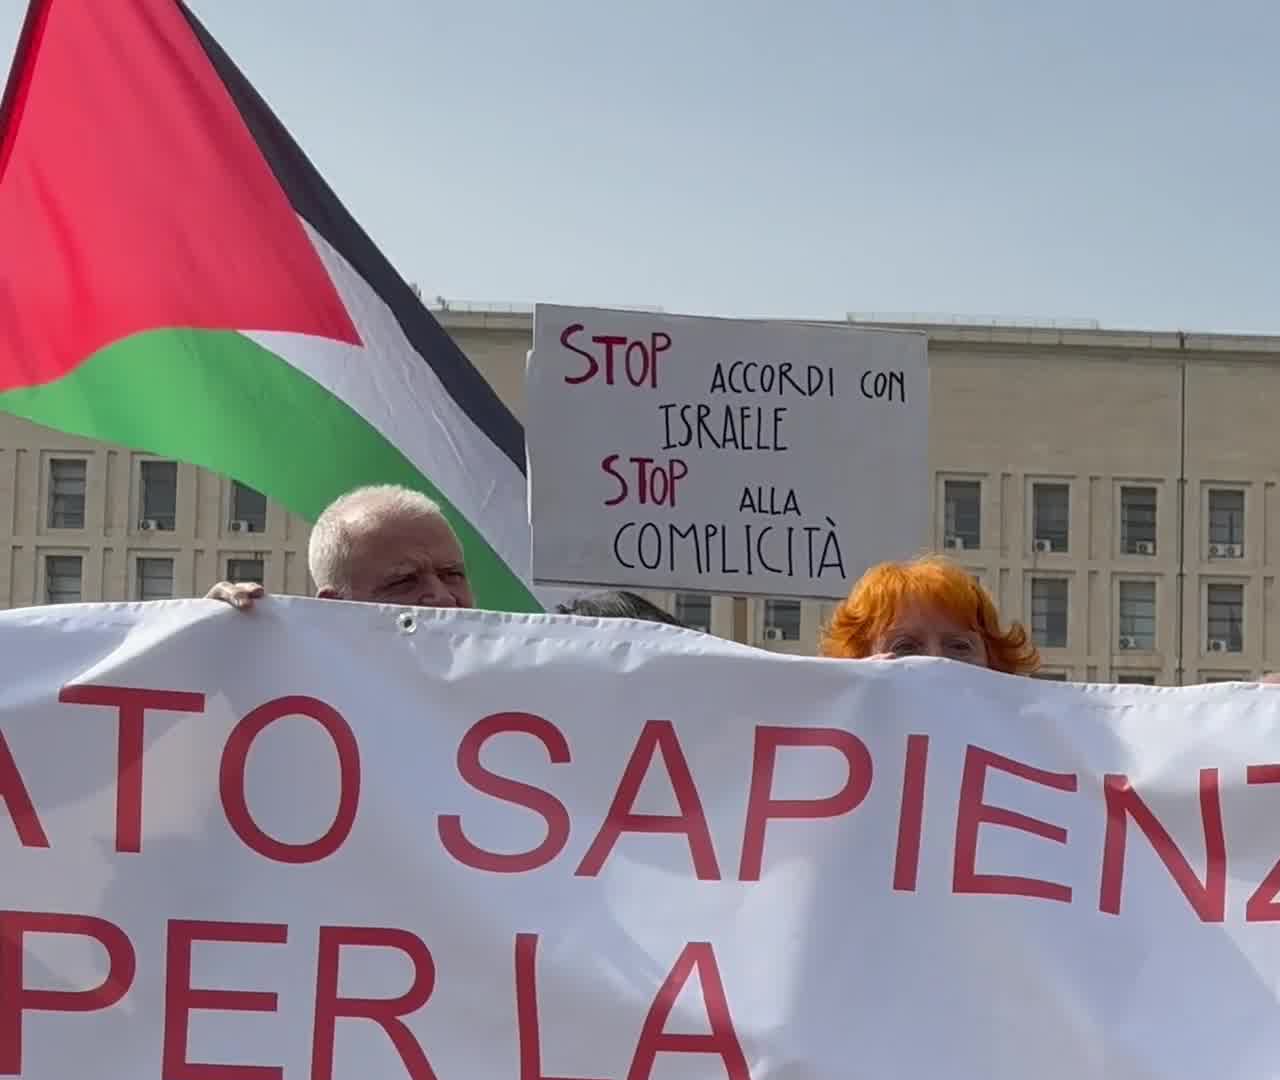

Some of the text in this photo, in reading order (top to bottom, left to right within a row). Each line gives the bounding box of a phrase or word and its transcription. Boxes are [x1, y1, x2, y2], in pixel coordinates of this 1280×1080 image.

[560, 323, 905, 402] STOP ACCORDI CON
[659, 403, 788, 451] ISRAELE
[601, 454, 801, 516] STOP ALLA
[613, 516, 846, 580] COMPLICITÀ
